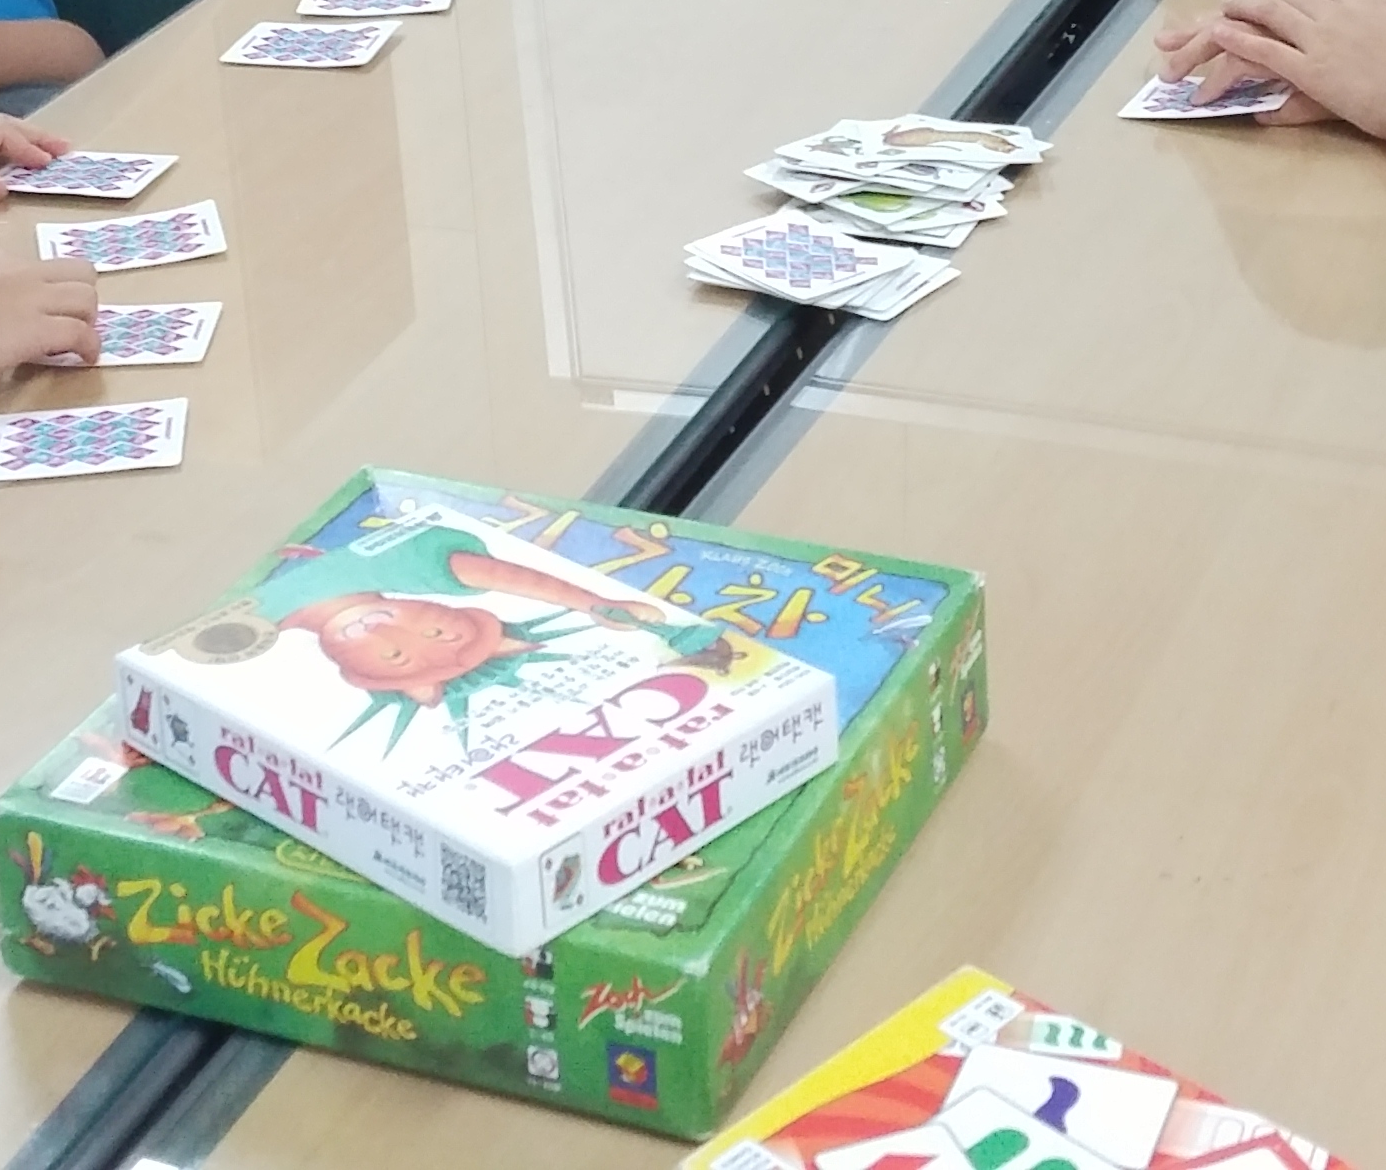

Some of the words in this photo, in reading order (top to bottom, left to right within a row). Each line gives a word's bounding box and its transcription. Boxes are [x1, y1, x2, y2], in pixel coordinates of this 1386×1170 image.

[215, 745, 328, 832] CAT
[471, 673, 709, 817] CAT
[597, 769, 733, 886] CAT
[116, 877, 293, 950] Zicke
[286, 889, 488, 1017] Zacke
[201, 948, 417, 1041] Hühnerkacke
